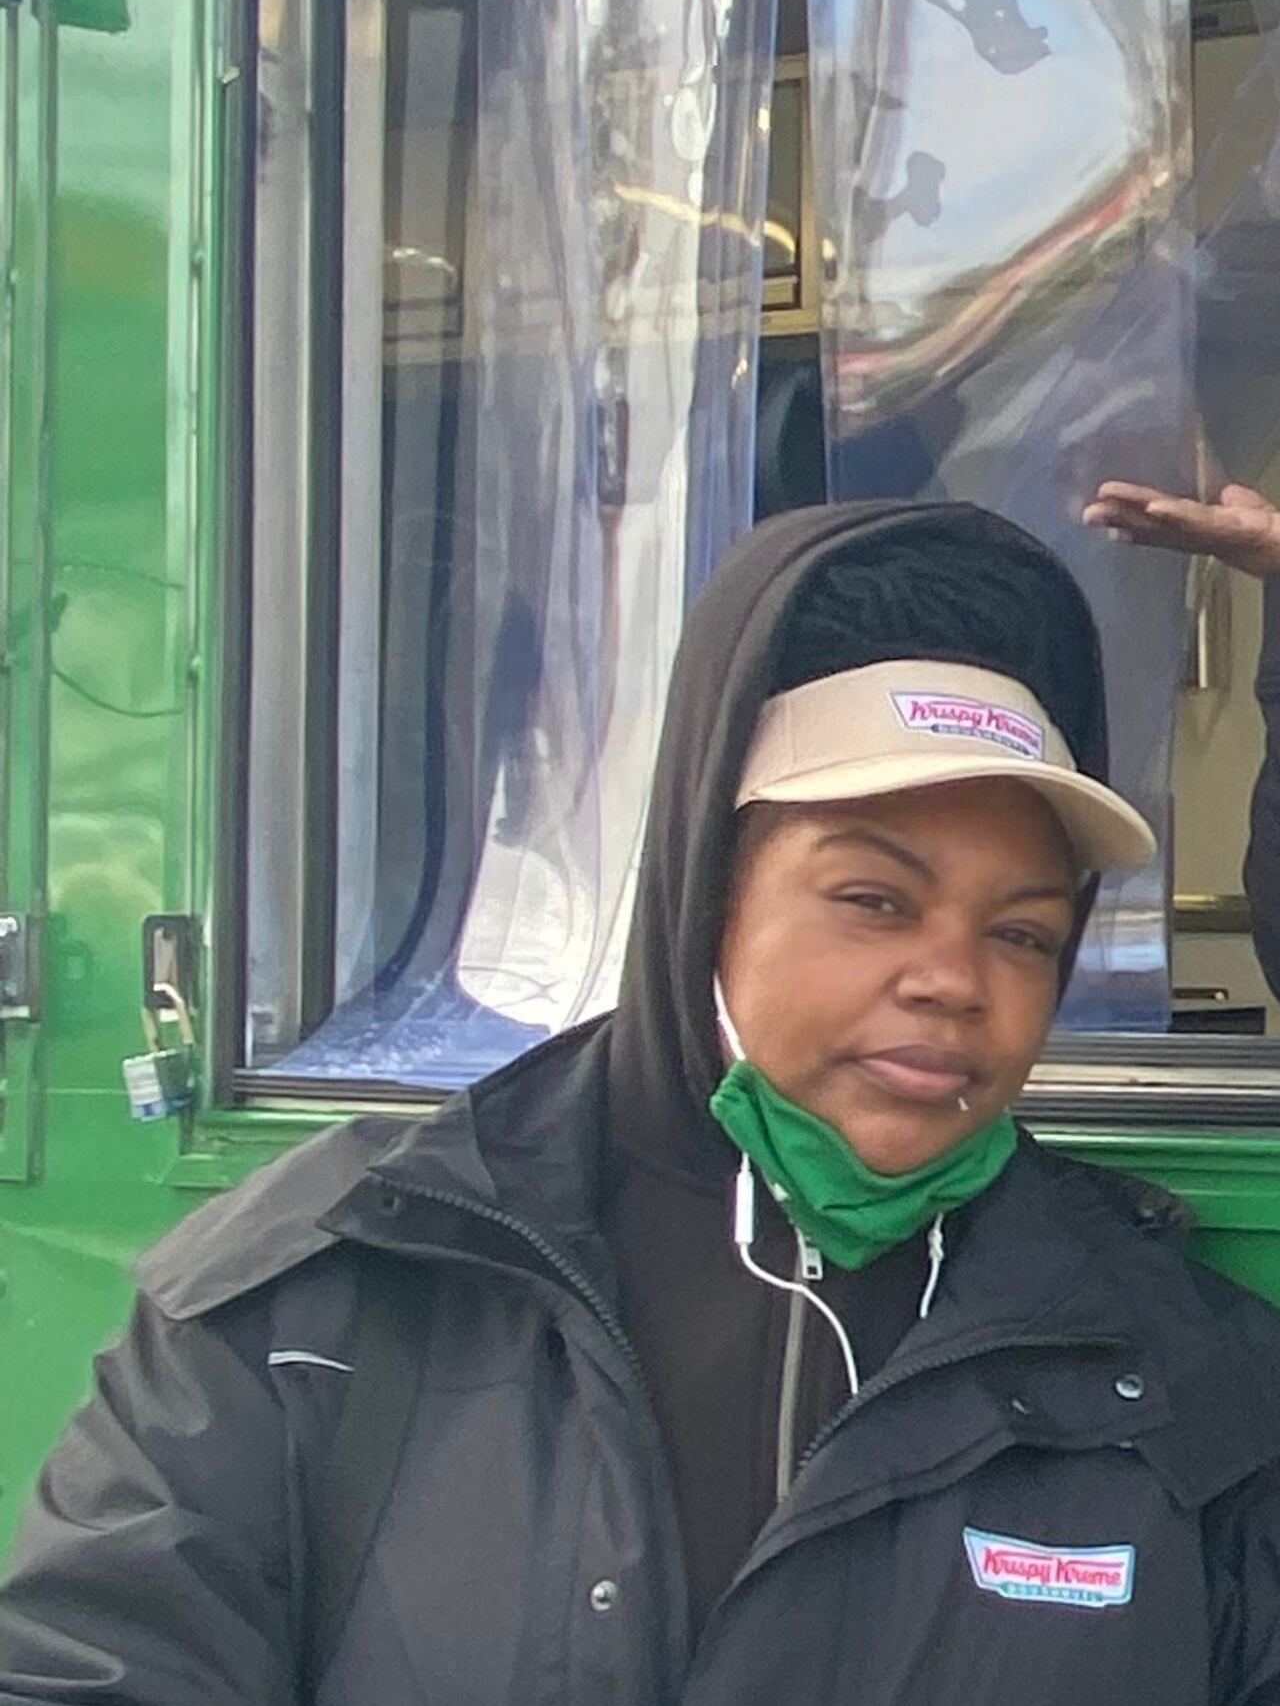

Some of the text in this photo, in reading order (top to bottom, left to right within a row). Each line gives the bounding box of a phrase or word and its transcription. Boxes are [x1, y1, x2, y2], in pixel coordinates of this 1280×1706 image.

[908, 700, 984, 727] Krispy
[983, 1547, 1125, 1586] Krispy Kreme
